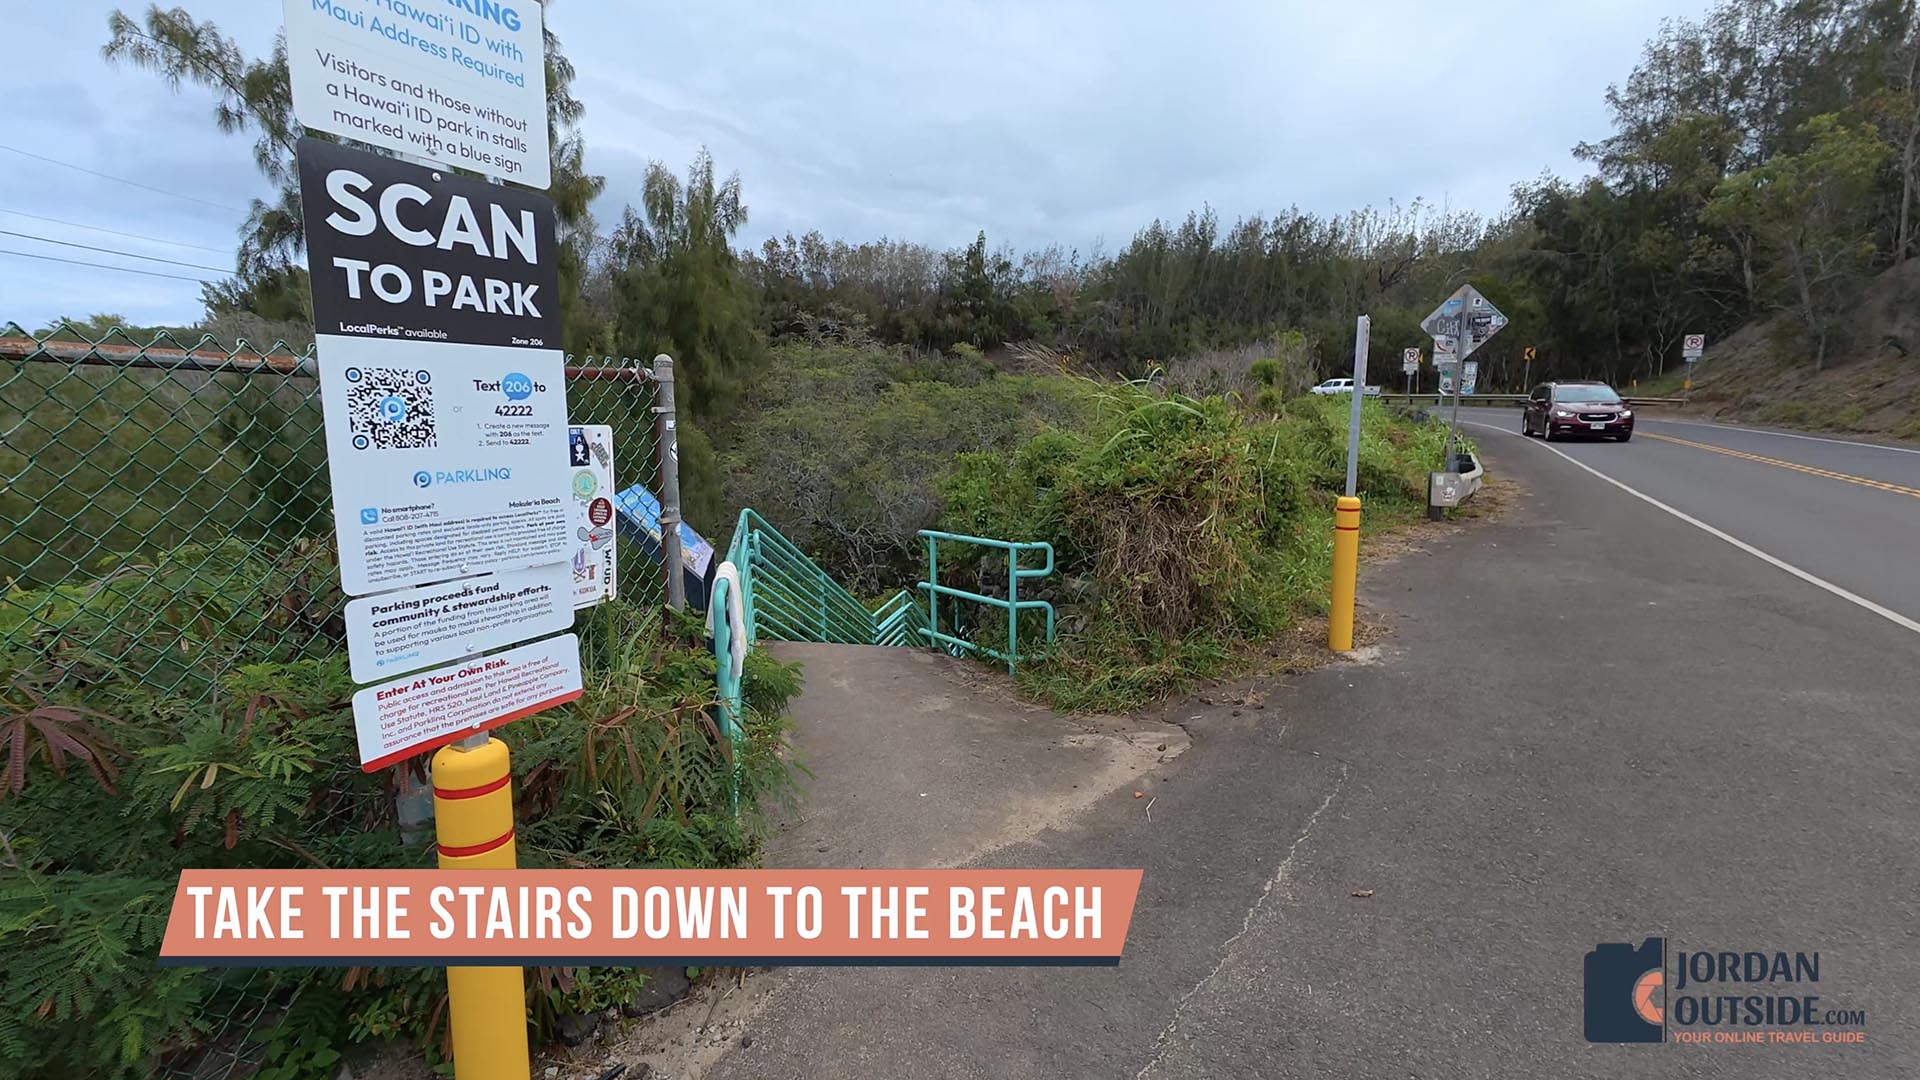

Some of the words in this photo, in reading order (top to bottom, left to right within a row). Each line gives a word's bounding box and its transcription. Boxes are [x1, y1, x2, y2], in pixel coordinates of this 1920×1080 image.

[312, 0, 364, 28] Maui
[370, 17, 447, 59] Address
[452, 47, 525, 88] Required
[460, 22, 480, 45] ID
[485, 37, 523, 63] with
[315, 48, 387, 87] Visitors
[391, 79, 423, 98] and
[427, 88, 471, 114] those
[474, 106, 527, 132] without
[326, 83, 338, 97] a
[415, 106, 433, 124] ID
[437, 117, 473, 137] park
[476, 126, 489, 142] in
[492, 133, 527, 153] stalls
[333, 110, 404, 140] marked
[408, 131, 442, 151] with
[446, 143, 457, 155] a
[460, 142, 491, 164] blue
[494, 154, 522, 173] sign
[325, 169, 538, 265] SCAN
[333, 257, 413, 304] TO
[423, 270, 543, 318] PARK
[405, 328, 448, 340] available
[511, 336, 529, 346] Zone
[530, 338, 544, 347] 206
[473, 379, 501, 392] Text
[505, 381, 531, 393] 206
[534, 381, 547, 393] to
[484, 422, 505, 430] Create
[525, 422, 551, 431] message
[495, 405, 533, 417] 42222
[486, 439, 501, 447] Send
[500, 430, 513, 438] 206
[382, 514, 395, 523] Call
[392, 503, 435, 513] smartphone?
[541, 497, 560, 505] Beach
[371, 600, 421, 615] Parking
[422, 588, 473, 607] proceeds
[475, 583, 500, 594] fund
[372, 608, 440, 628] community
[442, 605, 450, 613] &
[452, 592, 516, 611] stewardship
[517, 585, 551, 597] efforts.
[382, 624, 412, 637] portion
[413, 622, 423, 630] of
[424, 619, 437, 627] the
[438, 614, 466, 625] funding
[467, 610, 485, 618] from
[486, 605, 498, 613] this
[499, 601, 523, 611] parking
[524, 596, 538, 604] area
[374, 640, 385, 648] be
[386, 635, 406, 645] used
[408, 632, 420, 640] for
[421, 626, 447, 637] mauka
[458, 617, 480, 628] makai
[480, 609, 520, 623] stewardship
[528, 601, 552, 612] addition
[375, 649, 384, 657] to
[386, 639, 429, 654] supporting
[431, 632, 458, 643] various
[458, 626, 475, 637] local
[477, 619, 511, 631] non-profit
[376, 686, 409, 701] Enter
[412, 679, 427, 691] At
[428, 674, 456, 685] Your
[458, 667, 483, 678] Own
[485, 659, 509, 671] Risk.
[378, 701, 400, 712] Public
[403, 692, 429, 703] access
[430, 686, 446, 696] and
[447, 677, 484, 692] admission
[506, 666, 521, 675] area
[380, 709, 407, 721] charge
[408, 703, 420, 711] for
[421, 690, 469, 707] recreational
[485, 681, 496, 689] Per
[521, 662, 559, 677] Recreational
[381, 720, 396, 730] Use
[429, 704, 446, 714] HRS
[465, 694, 483, 704] Maui
[484, 689, 501, 698] Land
[508, 676, 538, 689] Pineapple
[382, 731, 396, 740] Inc.
[397, 725, 413, 735] and
[414, 715, 446, 728] Parklinq
[447, 701, 491, 718] Corporation
[492, 696, 501, 704] do
[502, 693, 512, 701] not
[514, 687, 535, 697] extend
[536, 682, 547, 690] any
[383, 731, 422, 749] assurance
[423, 725, 440, 735] that
[441, 720, 454, 729] the
[455, 711, 487, 725] premises
[501, 700, 514, 710] safe
[526, 694, 538, 702] any
